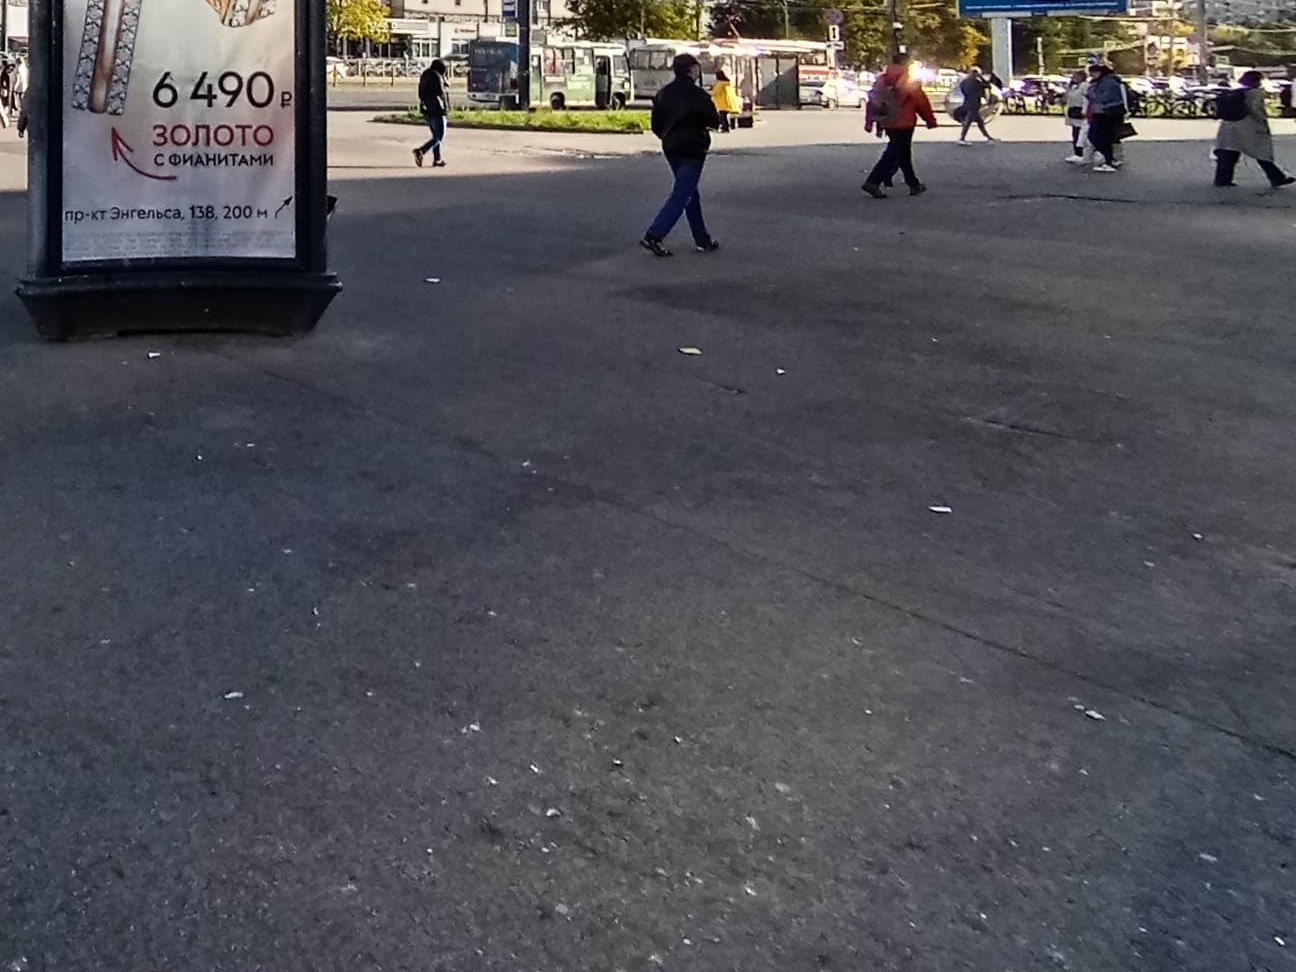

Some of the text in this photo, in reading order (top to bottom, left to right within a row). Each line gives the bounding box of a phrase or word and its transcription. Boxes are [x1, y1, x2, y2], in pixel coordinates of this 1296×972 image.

[153, 124, 274, 147] ЗОЛОТО
[154, 153, 274, 167] С ФИАНИТАМИ
[64, 205, 267, 224] пр-кт Энгельса, 138, 200 м
